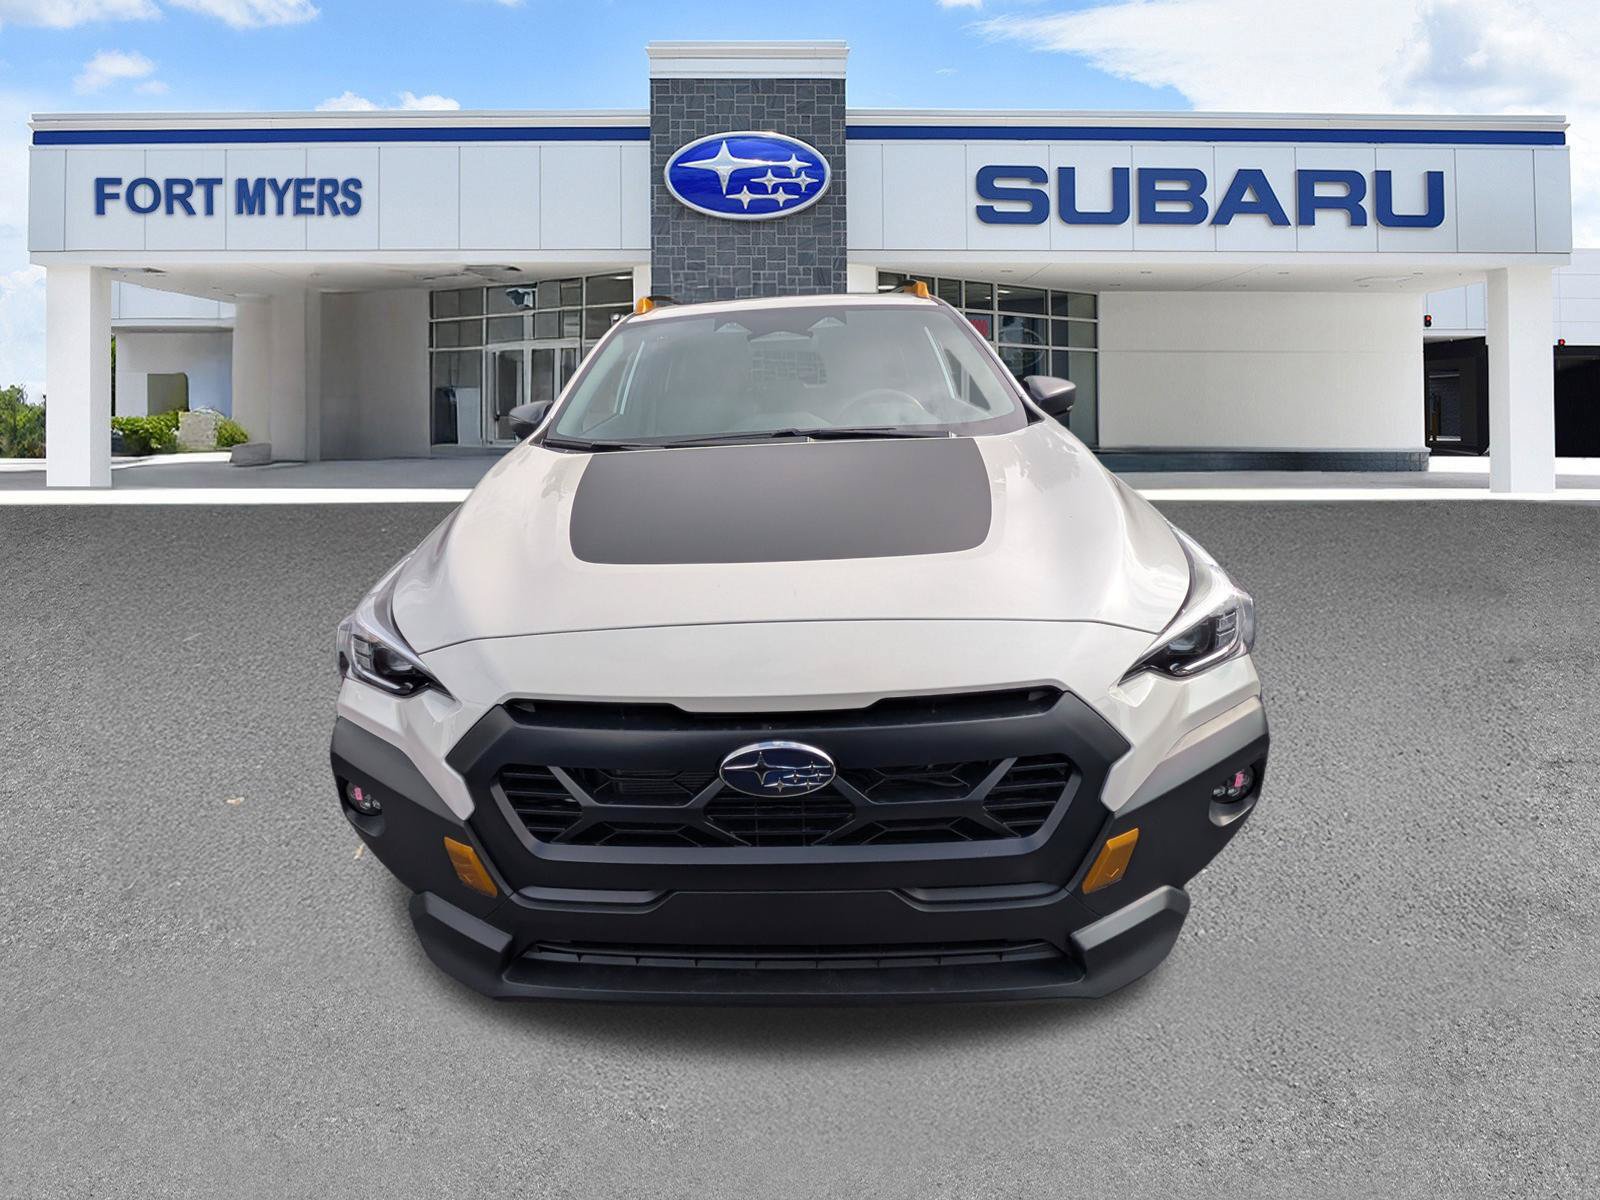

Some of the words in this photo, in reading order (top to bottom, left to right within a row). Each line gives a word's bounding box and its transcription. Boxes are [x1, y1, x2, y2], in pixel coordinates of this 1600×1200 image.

[95, 177, 223, 216] FORT
[235, 177, 363, 216] MYERS
[975, 165, 1446, 228] SUBARU
